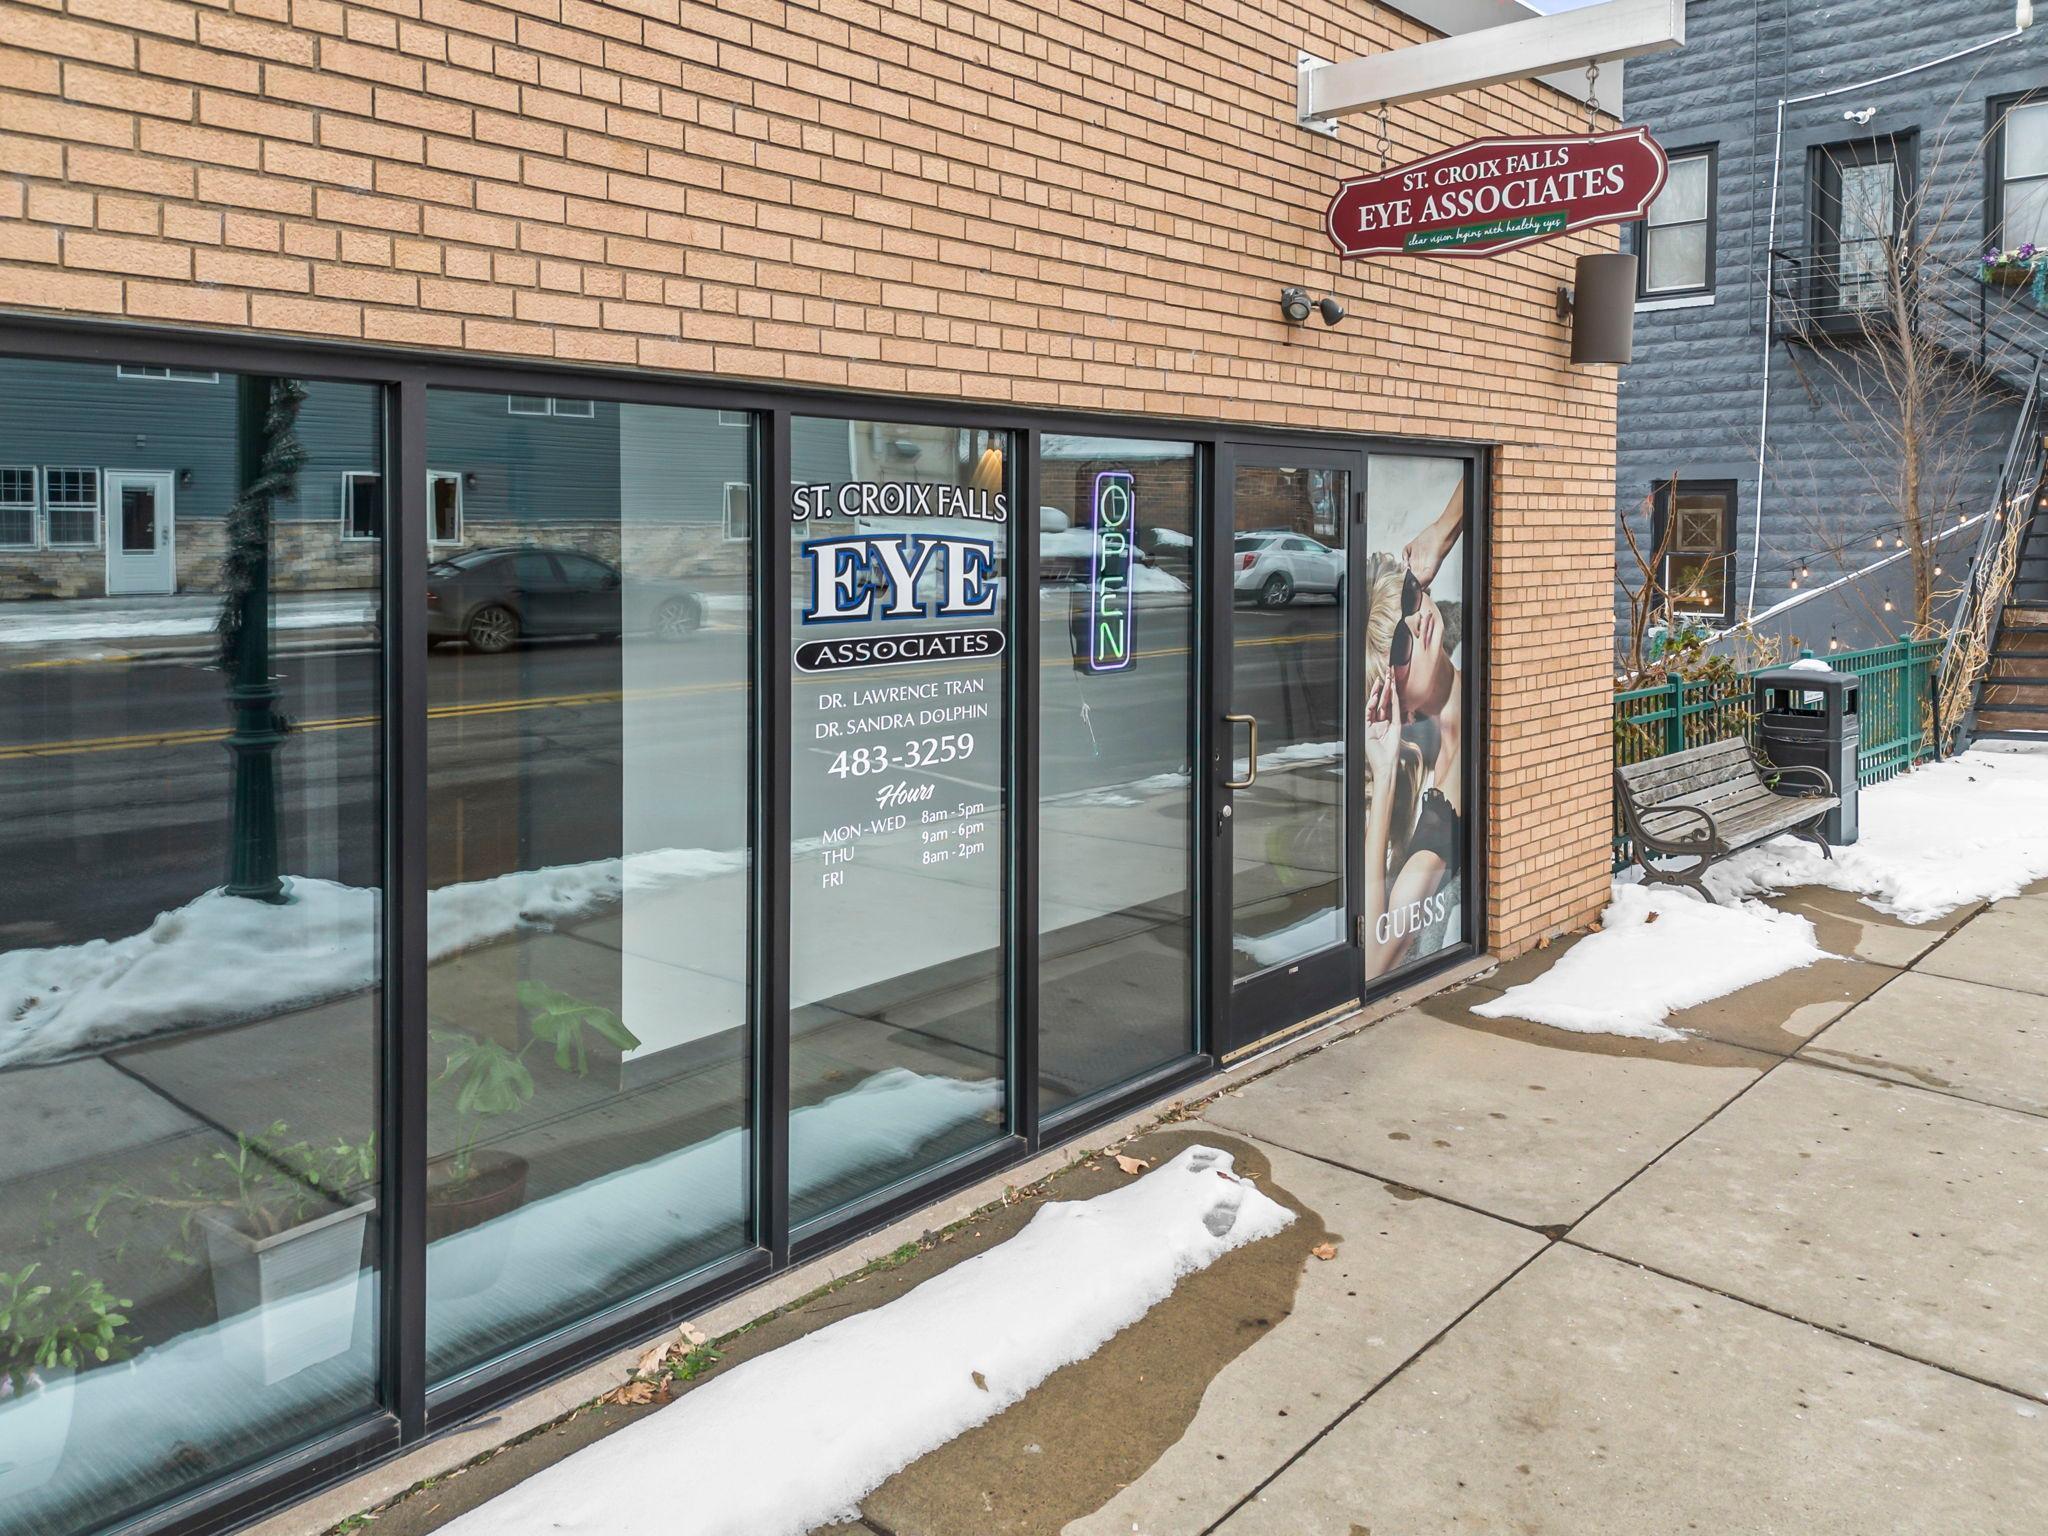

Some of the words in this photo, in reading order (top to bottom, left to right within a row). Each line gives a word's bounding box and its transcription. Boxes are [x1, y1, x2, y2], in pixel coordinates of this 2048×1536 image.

[1402, 170, 1431, 193] ST.
[1434, 157, 1502, 186] CROIX
[1506, 146, 1570, 175] FALLS
[1357, 199, 1413, 233] EYE
[1417, 163, 1626, 224] ASSOCIATES
[1408, 233, 1427, 247] clear
[1430, 232, 1454, 244] vision
[1456, 227, 1482, 244] begins
[1484, 221, 1505, 235] with
[1506, 217, 1541, 234] healthy
[1542, 218, 1562, 232] eyes
[792, 484, 832, 521] ST.
[837, 481, 934, 517] CROIX
[937, 484, 1008, 523] FALLS
[801, 533, 999, 626] EYE
[1098, 484, 1129, 662] OPEN
[813, 634, 990, 666] ASSOCIATES
[818, 693, 847, 710] DR.
[853, 682, 938, 707] LAWRENCE
[944, 678, 984, 697] TRAN
[815, 722, 844, 739] DR.
[846, 712, 915, 735] SANDRA
[919, 703, 988, 726] DOLPHIN
[827, 732, 974, 780] 483-3259
[875, 780, 936, 810] Hours
[921, 810, 948, 824] 8am
[958, 801, 984, 820] 5pm
[822, 846, 855, 866] THU
[921, 831, 948, 845] 9am
[958, 822, 984, 841] 6pm
[822, 870, 844, 889] FRI
[922, 852, 949, 865] 8am
[958, 842, 985, 860] 2pm
[1375, 892, 1446, 945] GUESS
